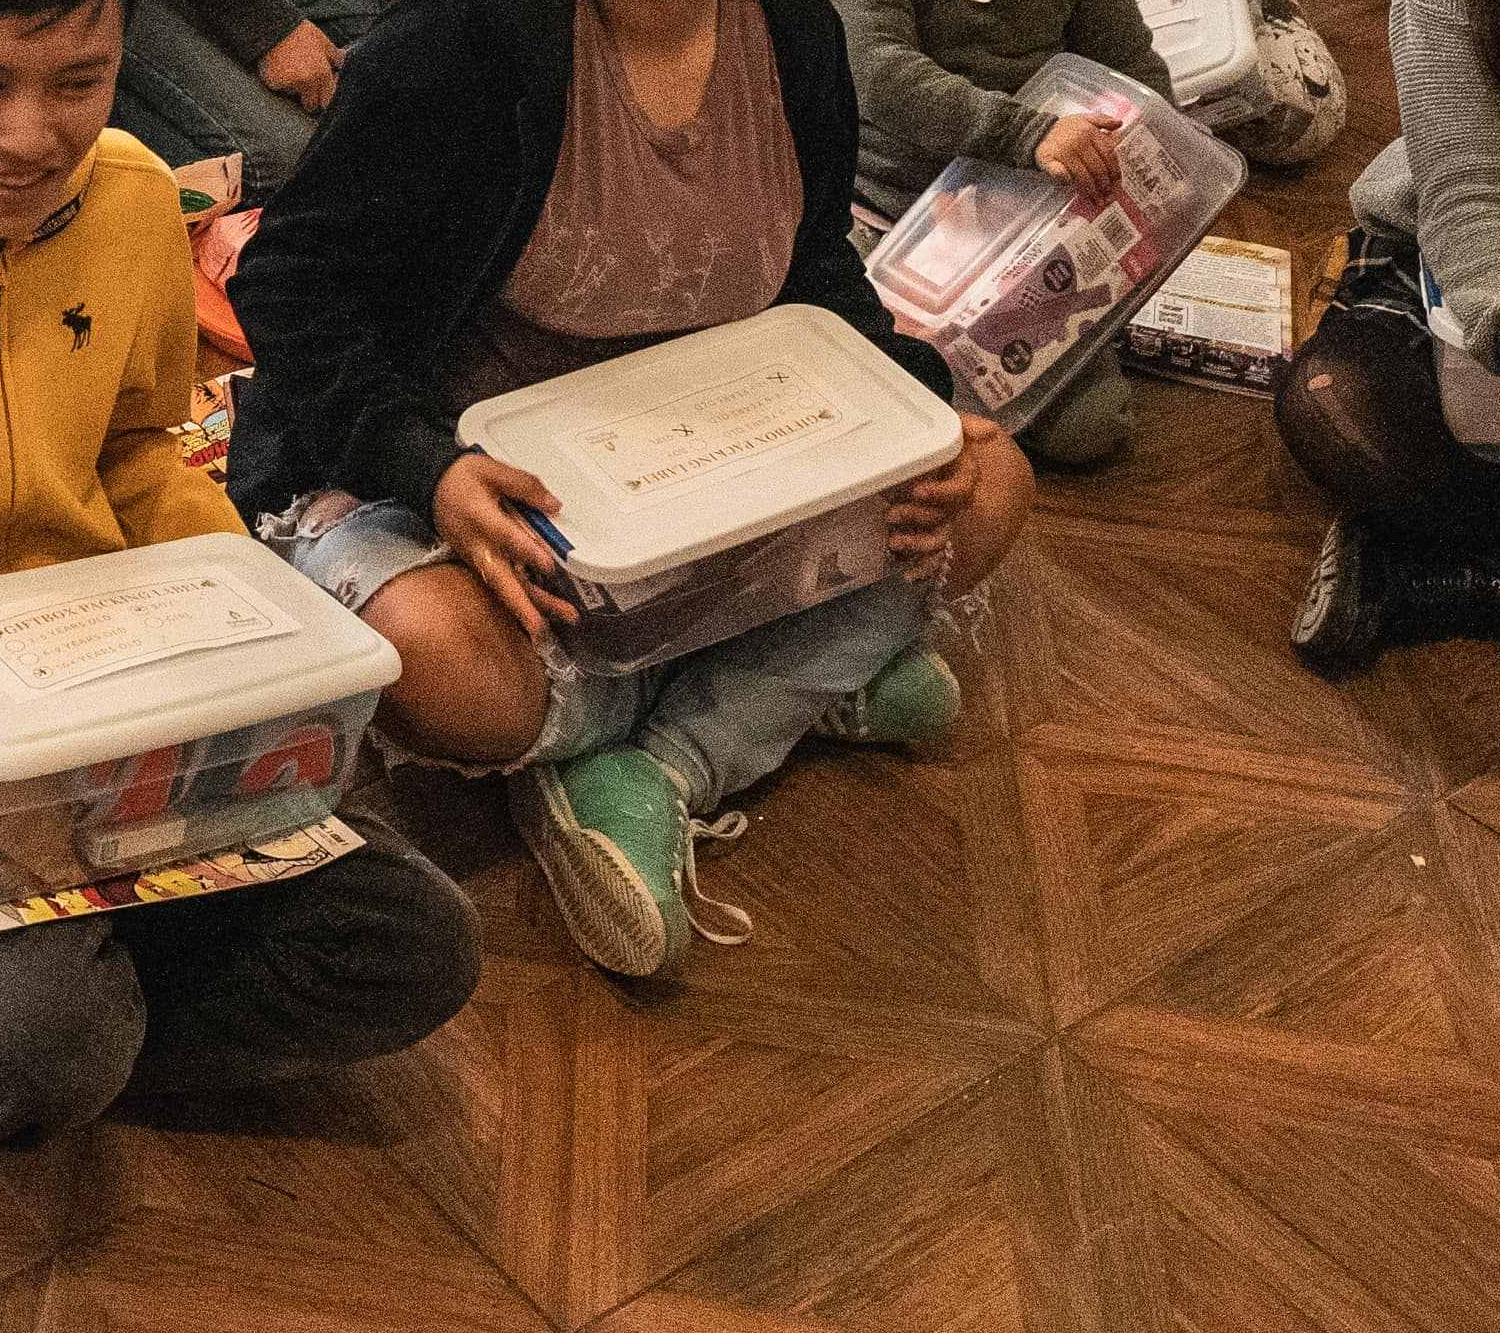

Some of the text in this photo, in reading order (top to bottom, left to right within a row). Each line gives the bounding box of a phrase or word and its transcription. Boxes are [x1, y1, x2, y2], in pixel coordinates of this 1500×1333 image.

[685, 435, 755, 472] PACKING
[635, 459, 688, 489] LABEL
[73, 588, 158, 615] PACKING
